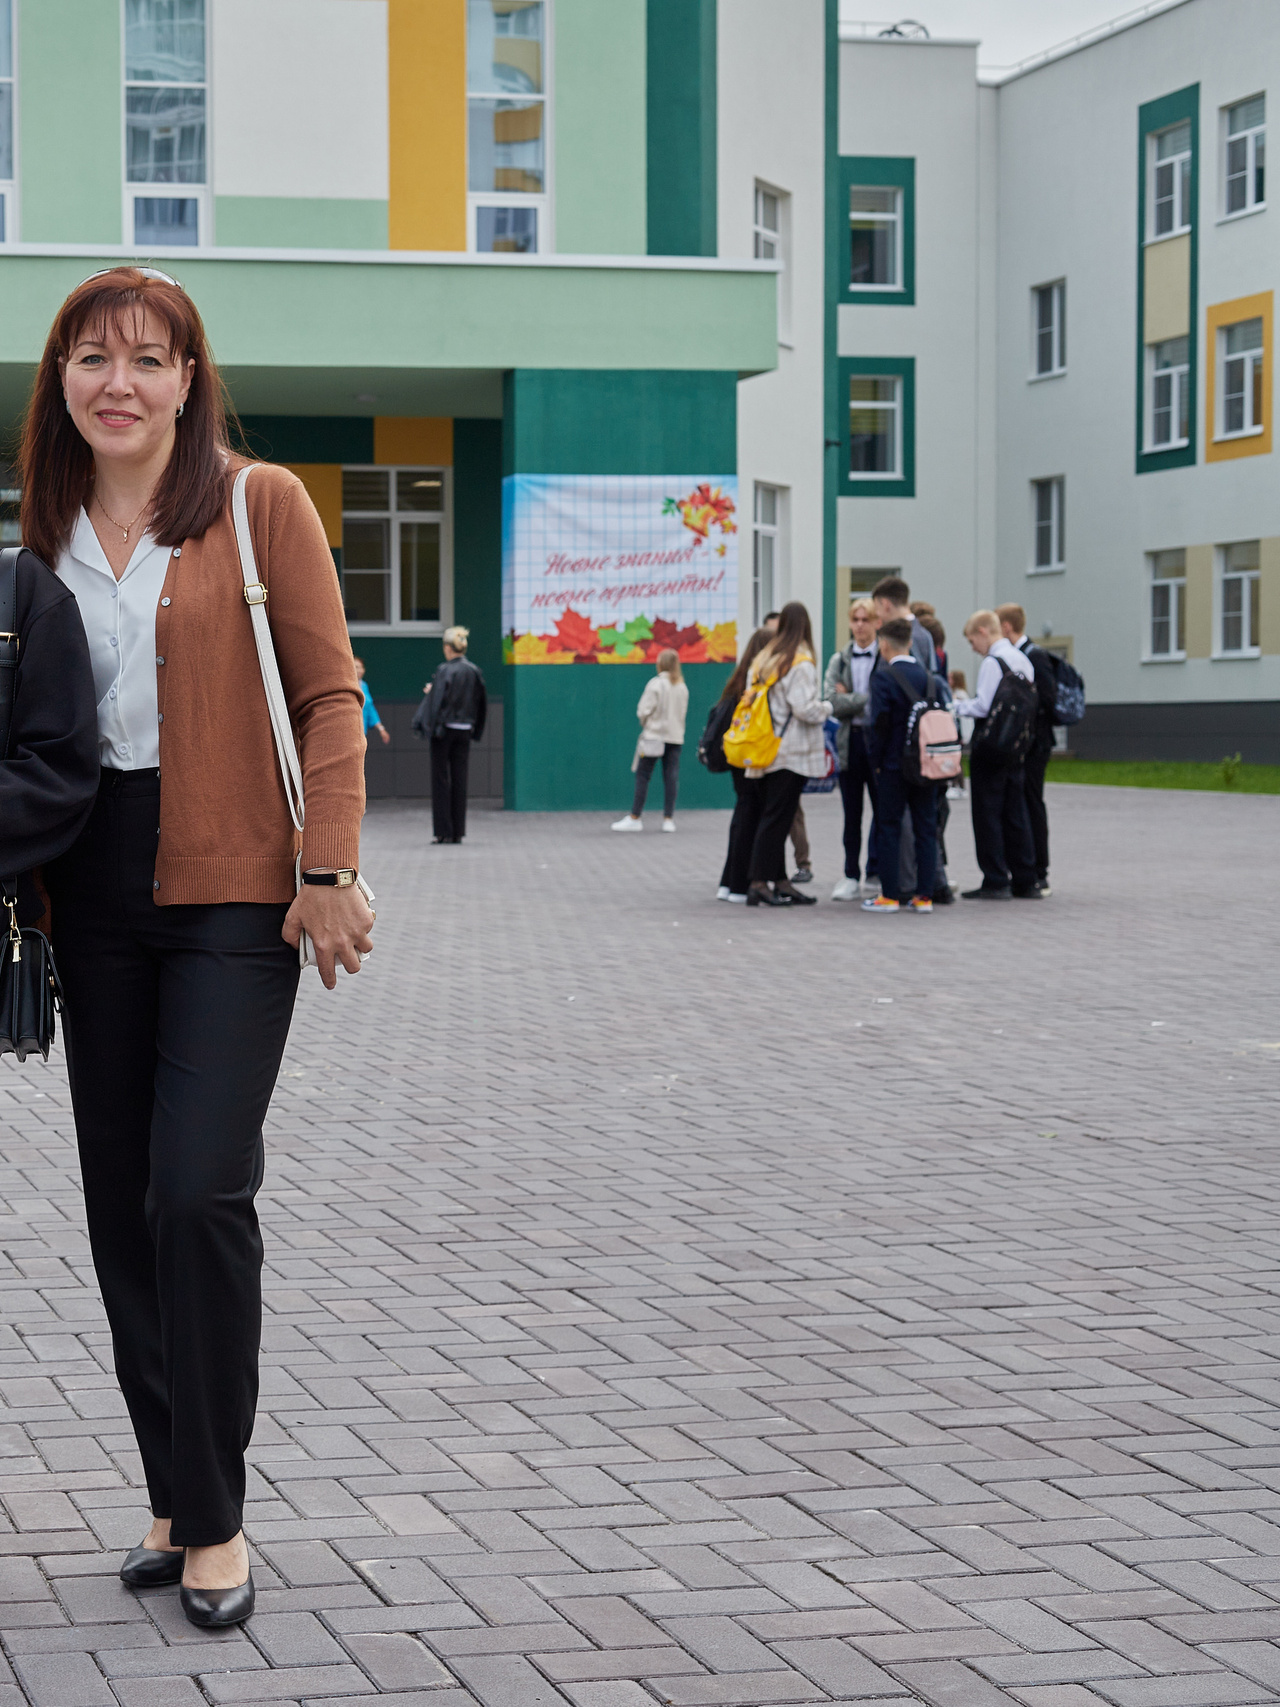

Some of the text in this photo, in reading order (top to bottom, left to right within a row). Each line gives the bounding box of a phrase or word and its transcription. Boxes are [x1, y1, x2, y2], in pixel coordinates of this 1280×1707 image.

[544, 553, 611, 576] Новые
[614, 547, 695, 570] знания
[531, 570, 725, 608] новые горизонты!
